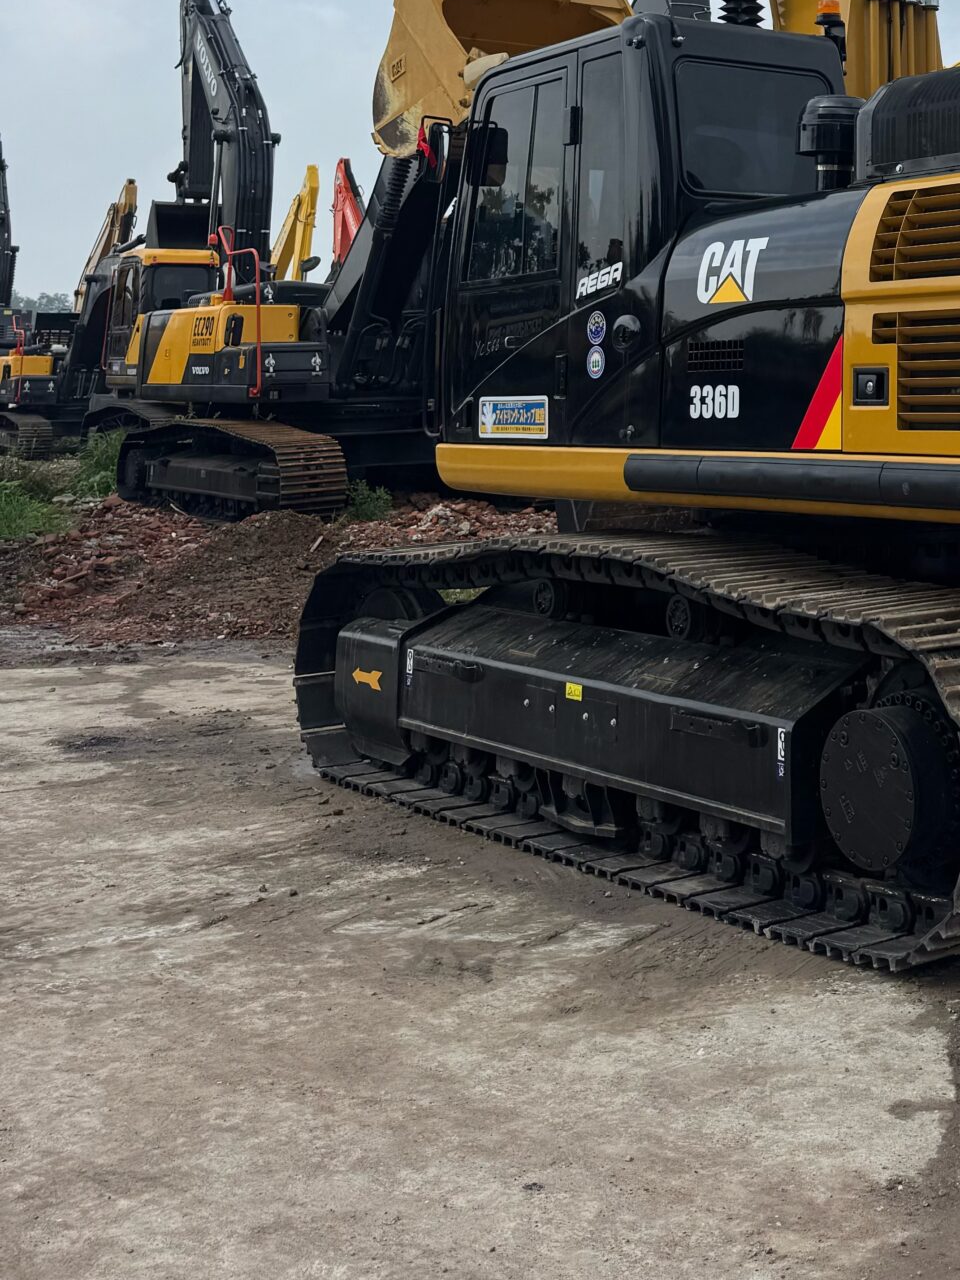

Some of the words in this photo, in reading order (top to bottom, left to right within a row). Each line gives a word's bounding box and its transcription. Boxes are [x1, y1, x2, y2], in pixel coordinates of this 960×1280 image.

[196, 30, 218, 97] VOLVO
[575, 261, 624, 300] REGA
[696, 236, 770, 305] CAT
[192, 315, 215, 337] EC290
[191, 366, 210, 375] VOLVO
[689, 384, 740, 419] 336D
